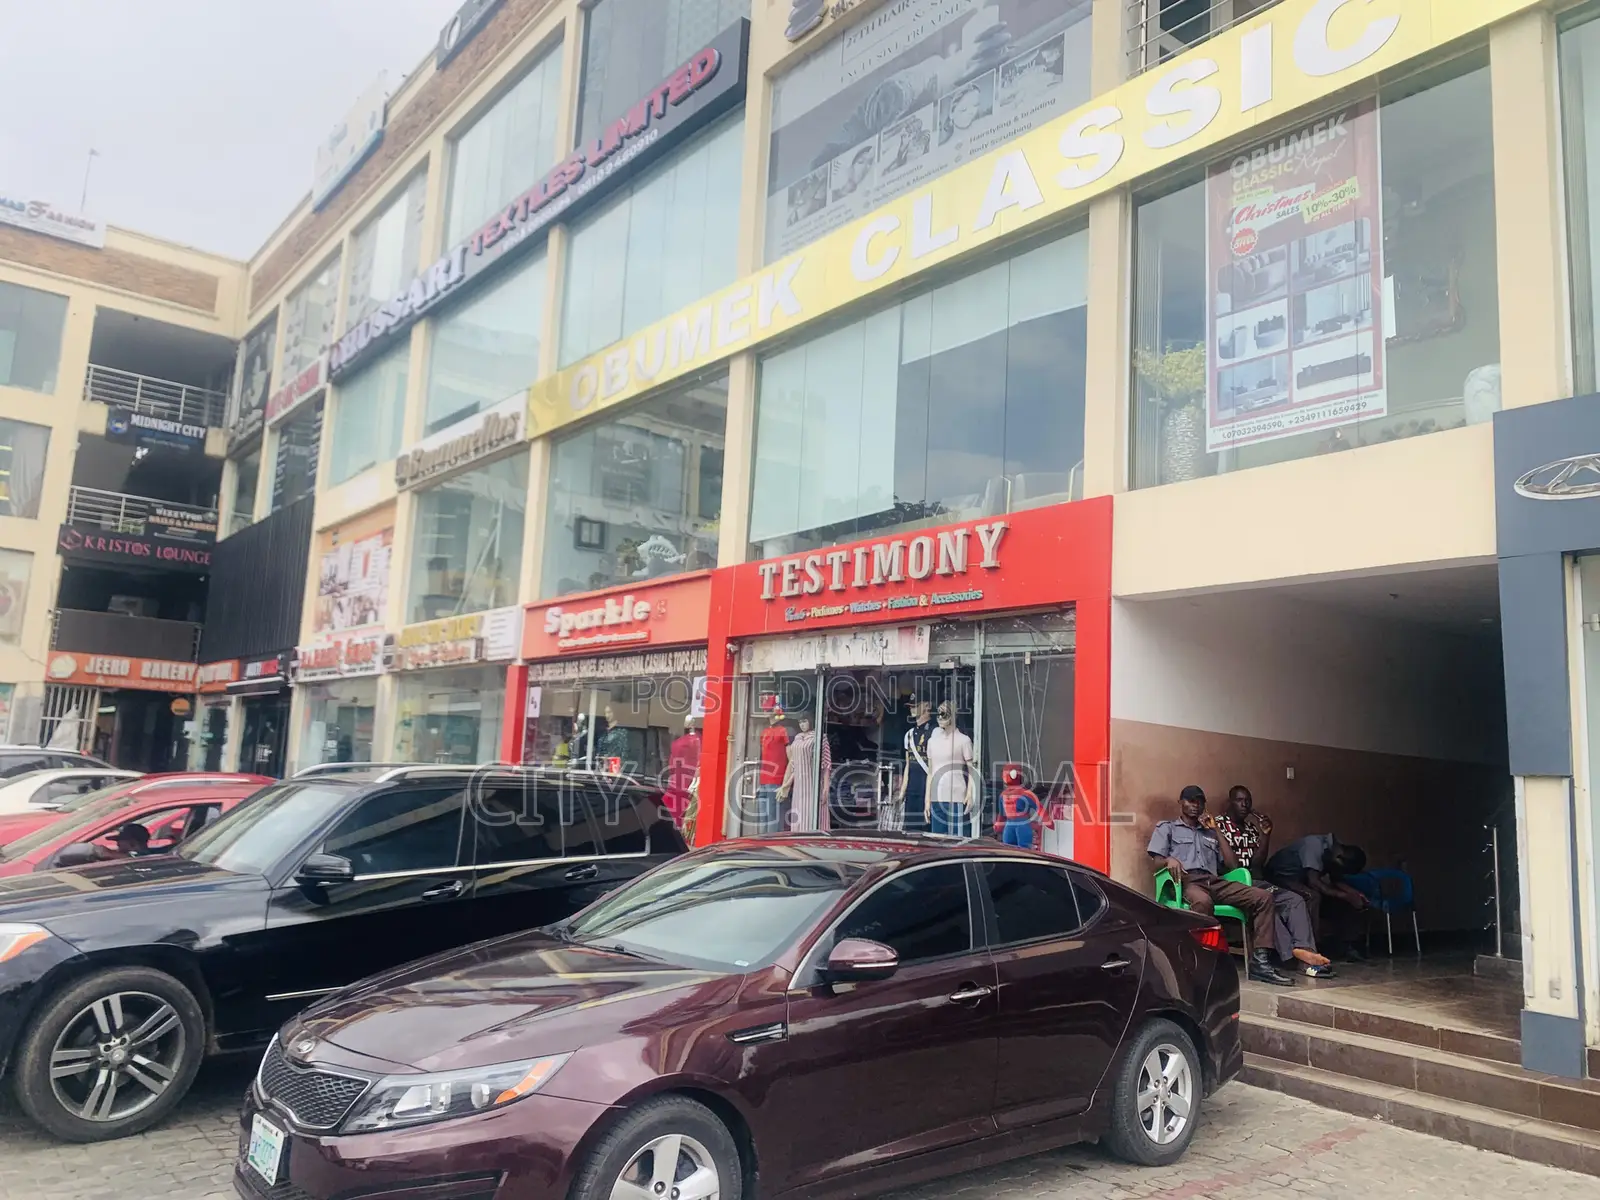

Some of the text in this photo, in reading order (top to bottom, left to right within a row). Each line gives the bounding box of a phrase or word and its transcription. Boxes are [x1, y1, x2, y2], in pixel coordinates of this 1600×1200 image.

[969, 119, 1012, 144] Hairstyling
[1020, 97, 1057, 119] braiding
[470, 153, 587, 256] TEXTILES
[587, 47, 721, 168] LIMITED
[1230, 112, 1348, 178] OBUMEK
[1232, 159, 1294, 193] CLASSIC
[569, 0, 1402, 411] OBUMEK CLASSIC
[1235, 189, 1313, 225] Christmas
[1275, 205, 1301, 220] SALES
[1305, 184, 1358, 216] 10%-30%
[131, 413, 206, 439] MIDNIGHT CITY
[84, 534, 151, 558] KRISTOS
[156, 545, 212, 565] LOUNGE
[758, 521, 1010, 600] TESTIMONY
[544, 595, 650, 638] Sparkle
[811, 604, 844, 618] Perfumes
[850, 601, 881, 613] Watches
[887, 595, 918, 609] Fashion
[919, 594, 929, 606] &
[931, 588, 984, 605] Accessories
[140, 661, 197, 682] BAKERY
